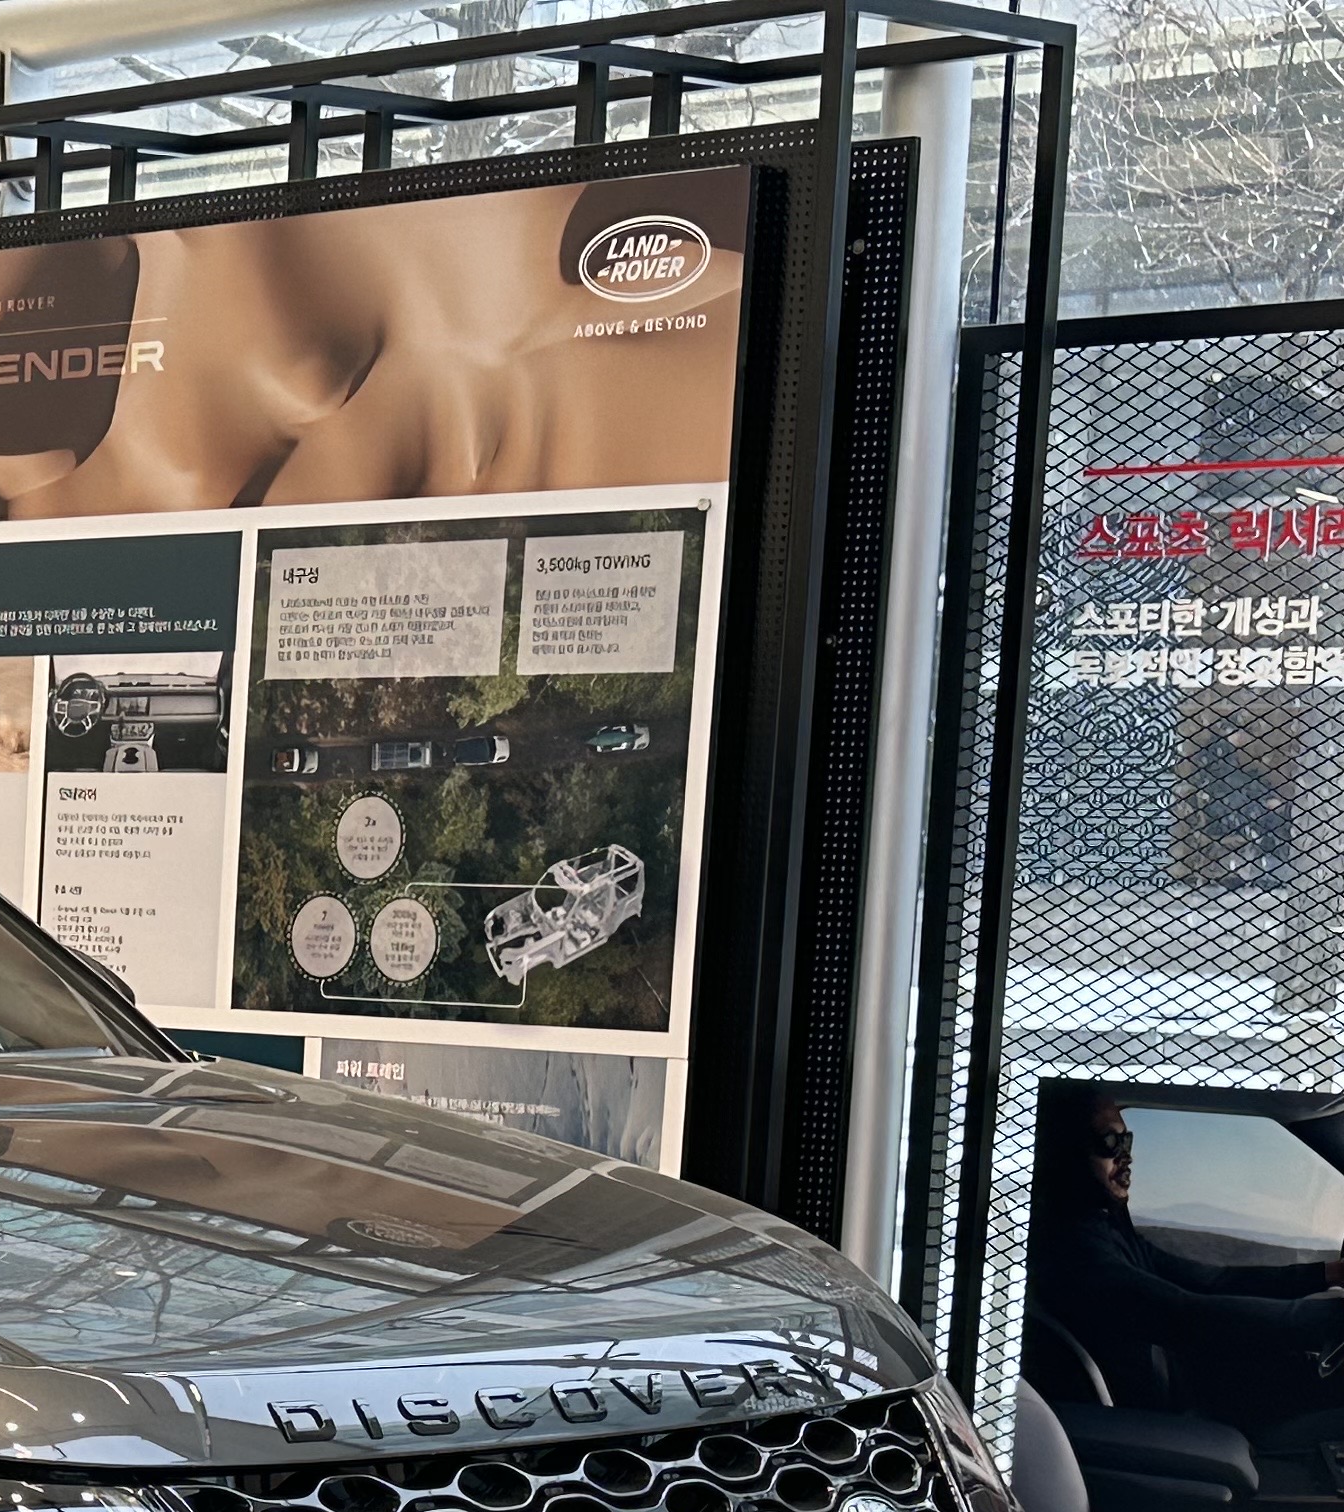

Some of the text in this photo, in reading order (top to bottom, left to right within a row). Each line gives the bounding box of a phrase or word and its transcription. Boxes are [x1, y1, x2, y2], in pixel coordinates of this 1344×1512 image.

[606, 233, 669, 261] LAND
[610, 255, 685, 284] ROVER
[6, 295, 56, 313] ROVER
[573, 314, 707, 339] ABOVE & BEYOND
[1075, 511, 1211, 559] 스포츠
[282, 566, 320, 585] 내구성
[536, 554, 651, 575] 3,500kg TOWING
[1072, 595, 1322, 638] 스포티한 개성과
[266, 1354, 838, 1444] DISCOVERY
